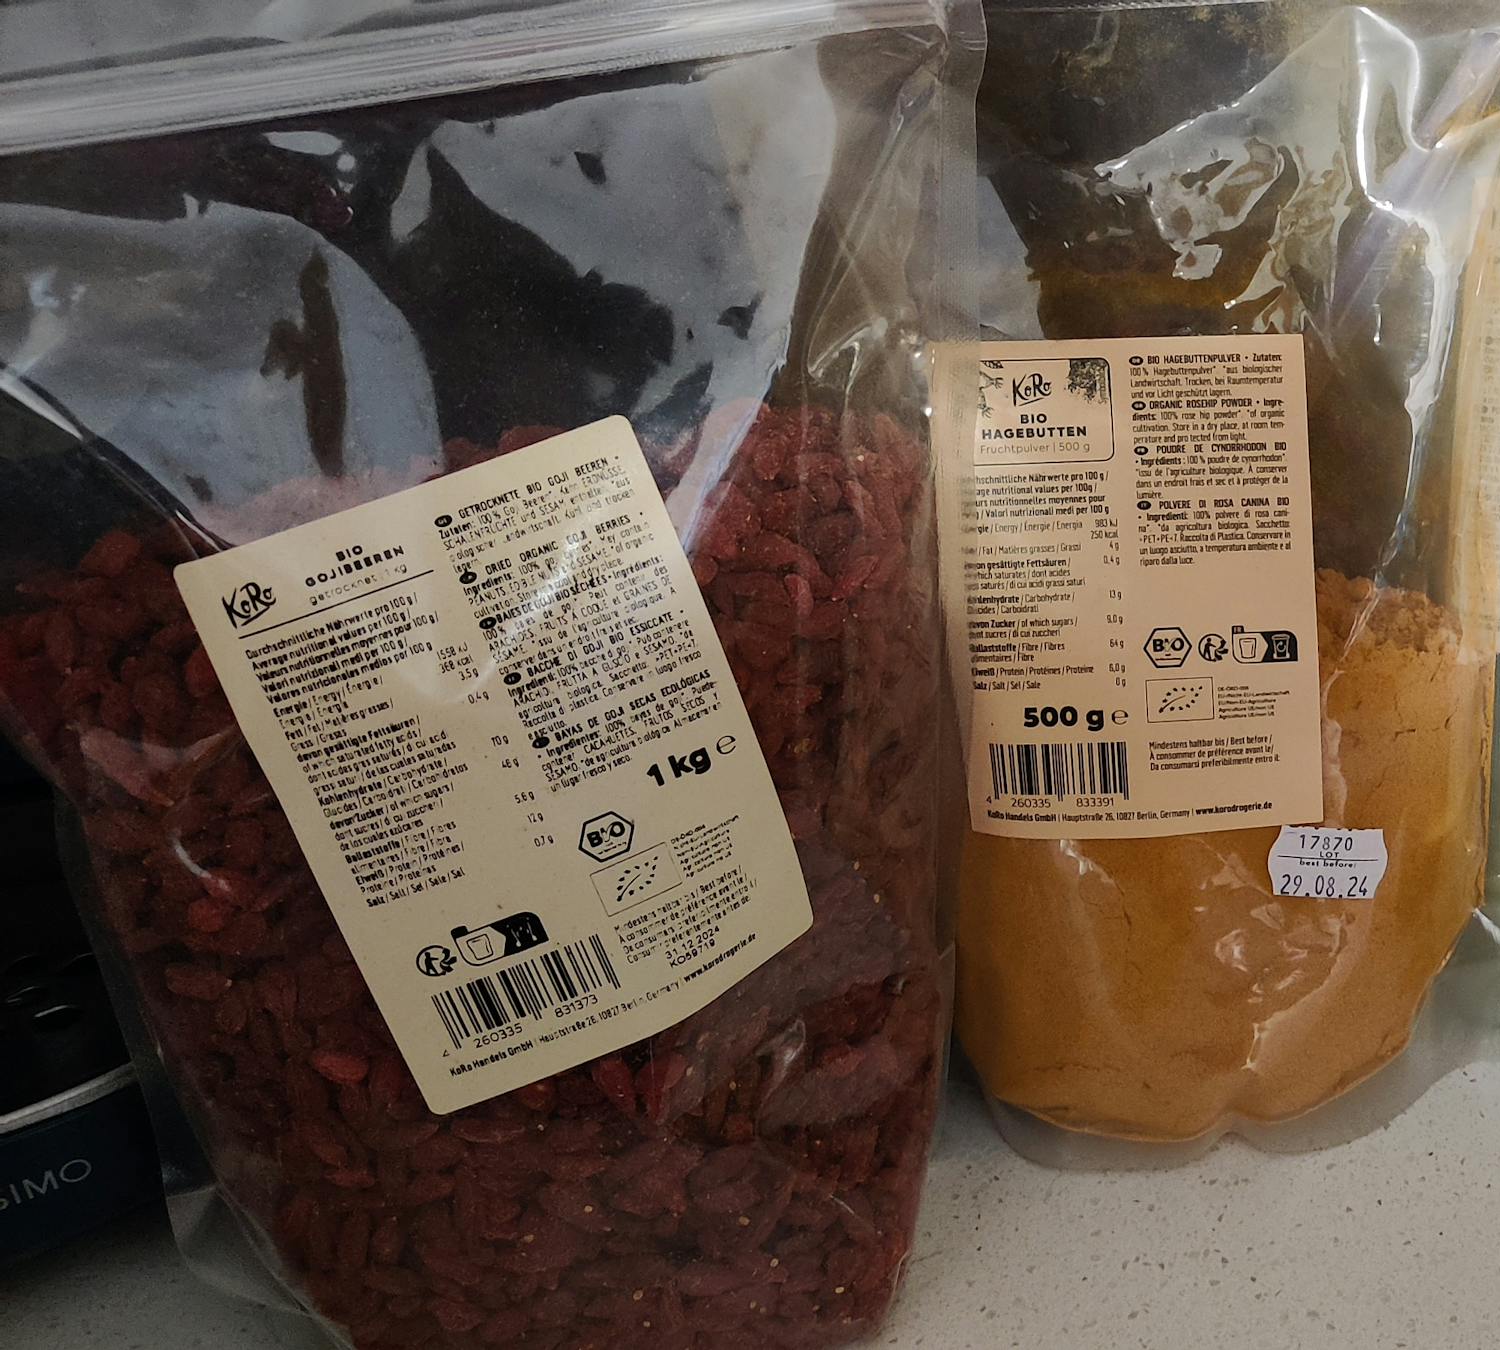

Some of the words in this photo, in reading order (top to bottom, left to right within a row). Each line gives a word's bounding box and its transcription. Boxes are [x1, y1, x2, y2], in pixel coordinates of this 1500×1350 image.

[1147, 356, 1159, 364] BIO
[1164, 354, 1241, 364] HAGEBUTTENPULVER
[1013, 373, 1051, 406] KoRo
[1150, 401, 1182, 409] ORGANIC
[1221, 399, 1252, 407] POWDER
[1020, 414, 1047, 424] BIO
[982, 426, 1087, 440] HAGEBUTTEN
[980, 444, 1049, 454] Fruchtpulver
[1059, 442, 1079, 451] 500
[1084, 443, 1090, 453] g
[1157, 445, 1185, 453] POUDRE
[1194, 444, 1202, 452] DE
[1275, 442, 1286, 450] BIO
[525, 481, 542, 494] BIO
[574, 457, 608, 476] BEEREN
[1071, 473, 1083, 481] pro
[1085, 472, 1097, 480] 100
[1100, 472, 1103, 481] g
[992, 486, 1033, 495] nutritional
[1035, 485, 1059, 493] values
[1061, 485, 1073, 493] per
[1159, 501, 1191, 509] POLVERE
[1214, 499, 1233, 507] ROSA
[1241, 498, 1269, 506] CANINA
[1277, 497, 1289, 505] BIO
[335, 544, 363, 562] BIO
[304, 545, 404, 587] GOJIBEEREN
[221, 581, 276, 628] KoRo
[388, 595, 406, 609] 100
[381, 611, 399, 625] 100
[608, 631, 624, 644] BIO
[628, 692, 656, 710] SECAS
[1024, 706, 1078, 727] 500
[1086, 709, 1104, 731] g
[1149, 741, 1187, 749] Mindestens
[1215, 738, 1224, 746] bis
[1231, 737, 1245, 745] Best
[1247, 736, 1268, 744] before
[646, 763, 665, 786] 1
[667, 746, 711, 778] kg
[1011, 798, 1051, 808] 260335
[1076, 797, 1114, 807] 833391
[1035, 813, 1056, 822] GmbH
[1160, 809, 1190, 819] Germany
[1196, 801, 1272, 816] www.korodrogerie.de
[1300, 835, 1352, 850] 17870
[1300, 858, 1319, 867] best
[1281, 874, 1367, 898] 29.08.24
[472, 1022, 522, 1048] 260335
[554, 993, 598, 1018] 831373
